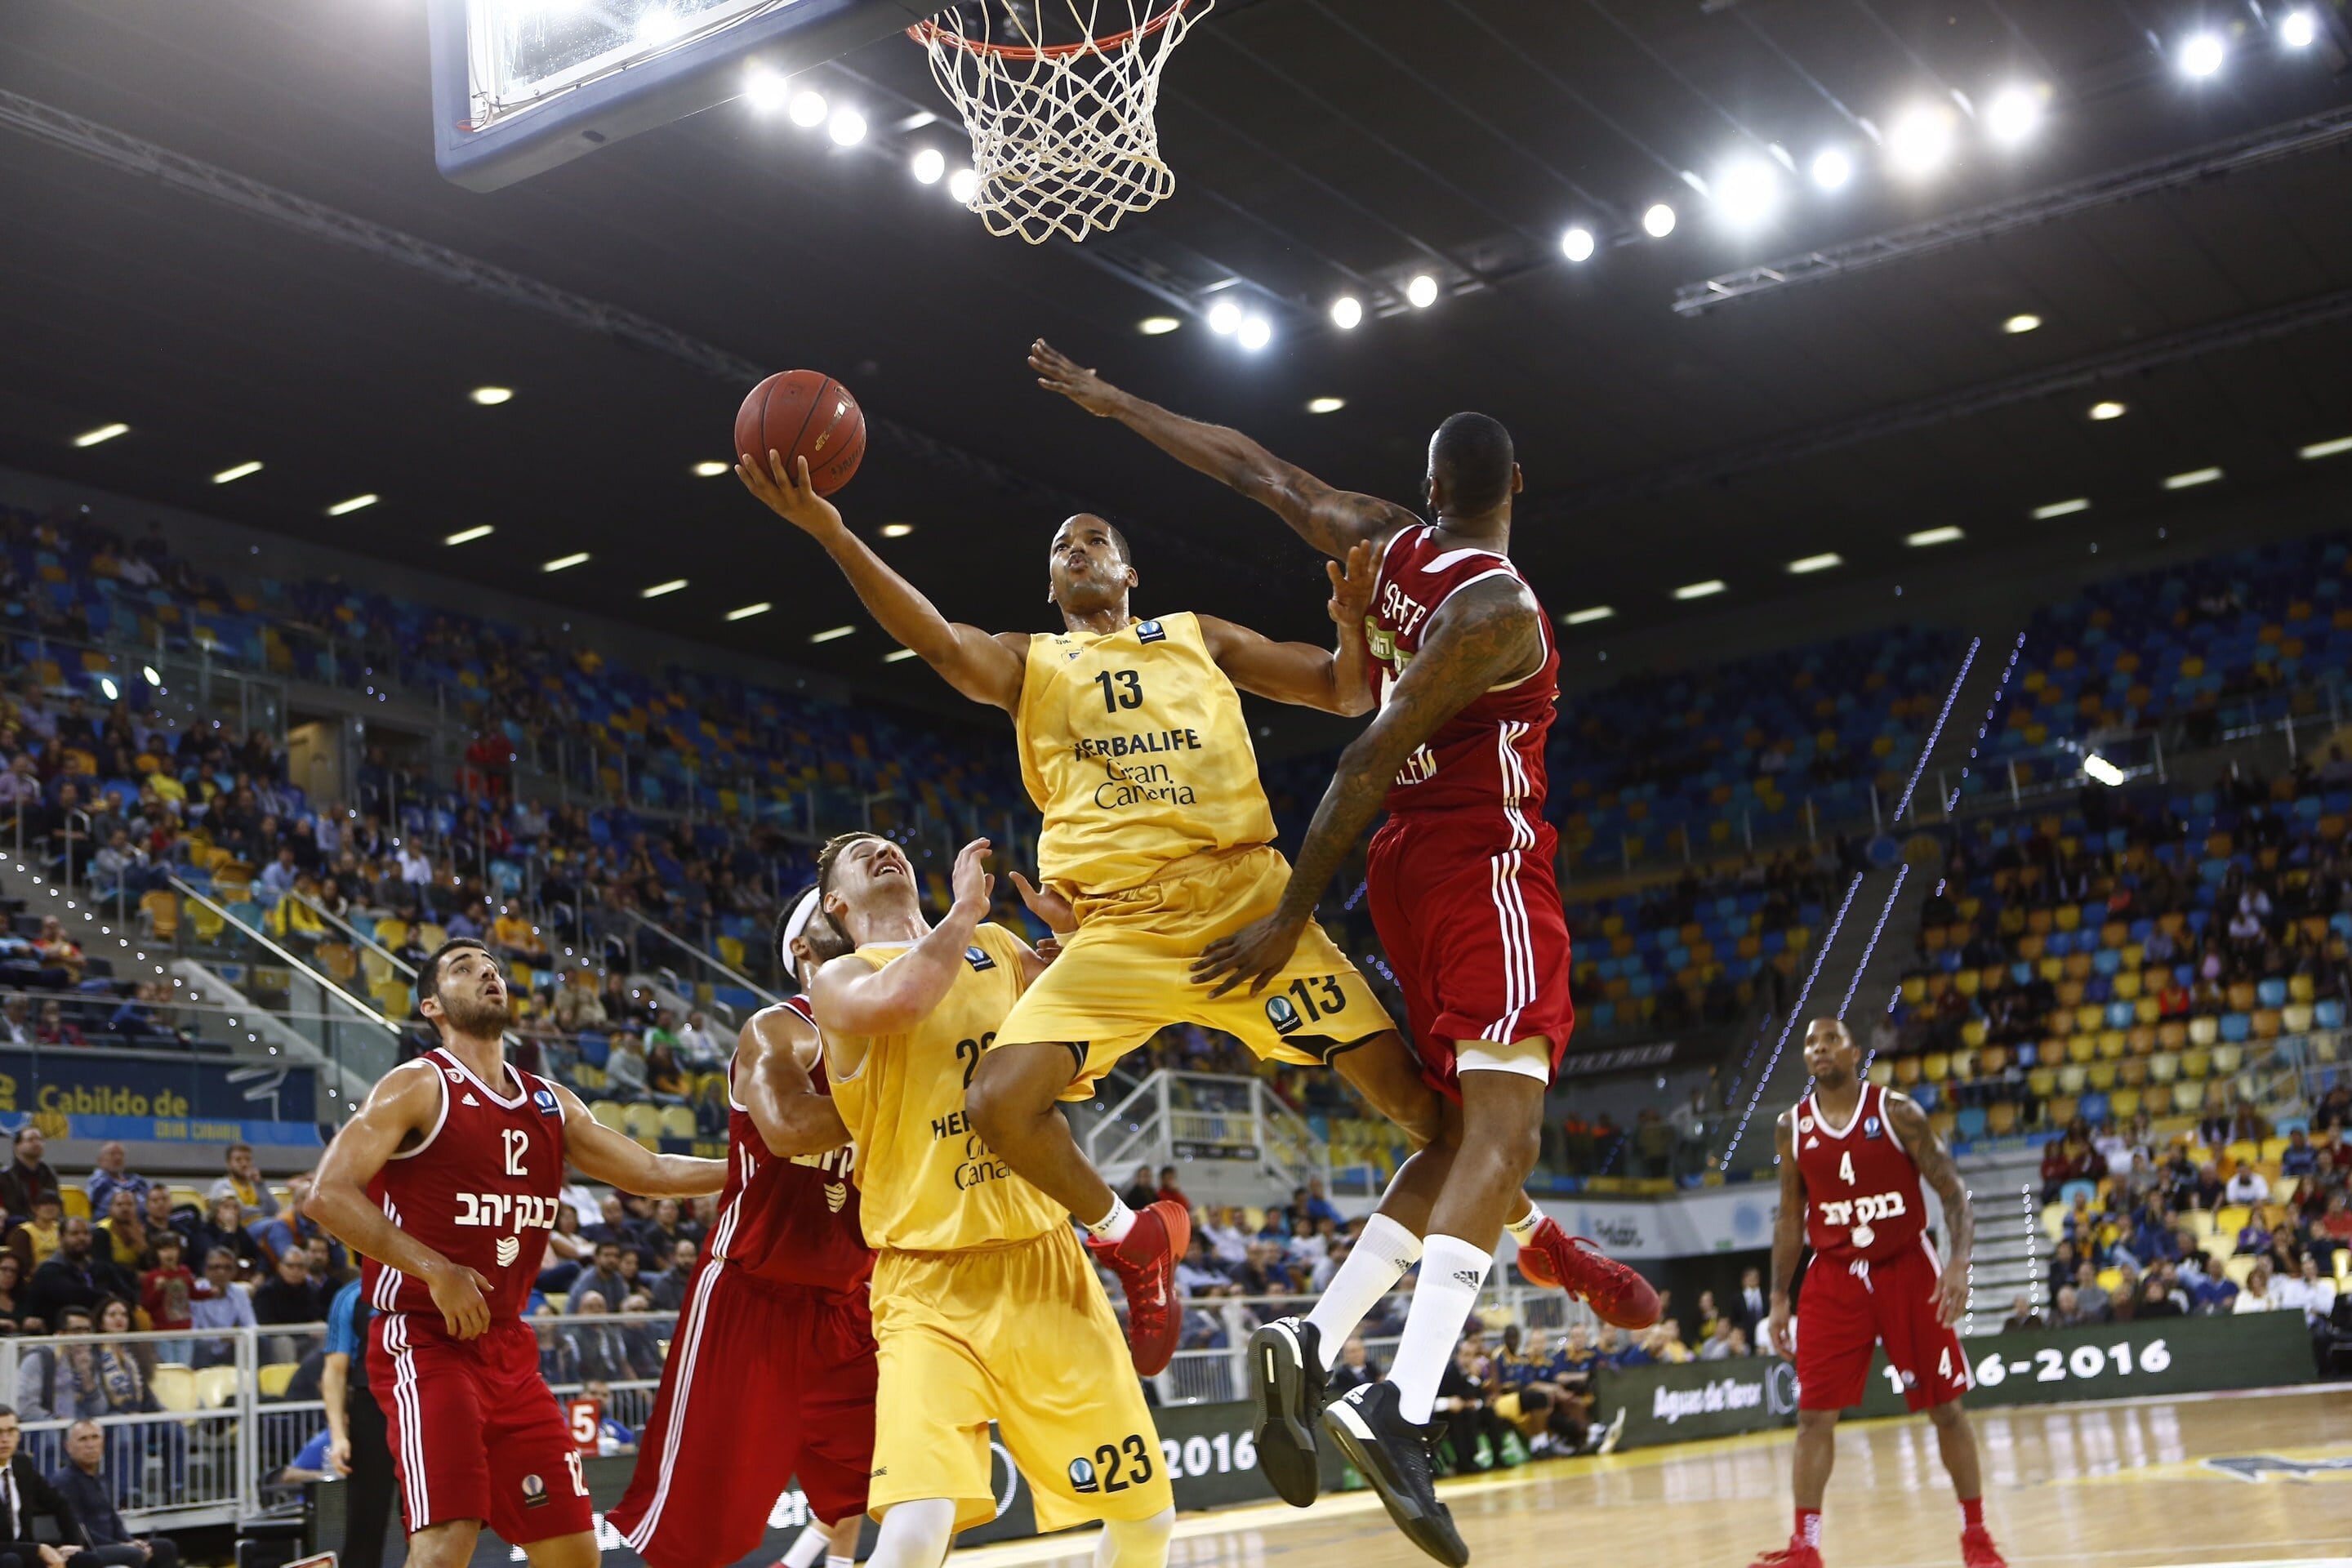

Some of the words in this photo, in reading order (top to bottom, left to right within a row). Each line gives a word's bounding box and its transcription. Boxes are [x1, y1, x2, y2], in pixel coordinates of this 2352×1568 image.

[1094, 670, 1143, 714] 13
[1074, 728, 1202, 761] HERBALIFE
[1106, 758, 1169, 784] Gran
[1094, 779, 1197, 810] Canaria
[1288, 974, 1347, 1023] 13
[38, 1084, 149, 1116] Cabildo
[153, 1089, 189, 1117] de
[501, 1128, 530, 1176] 12
[1839, 1150, 1855, 1187] 4
[454, 1192, 511, 1227] יהב
[1938, 1346, 1953, 1380] 4
[1653, 1385, 1704, 1424] Aguas
[1704, 1380, 1724, 1413] de
[572, 1403, 597, 1444] 5
[564, 1450, 590, 1497] 12
[1095, 1433, 1153, 1494] 23
